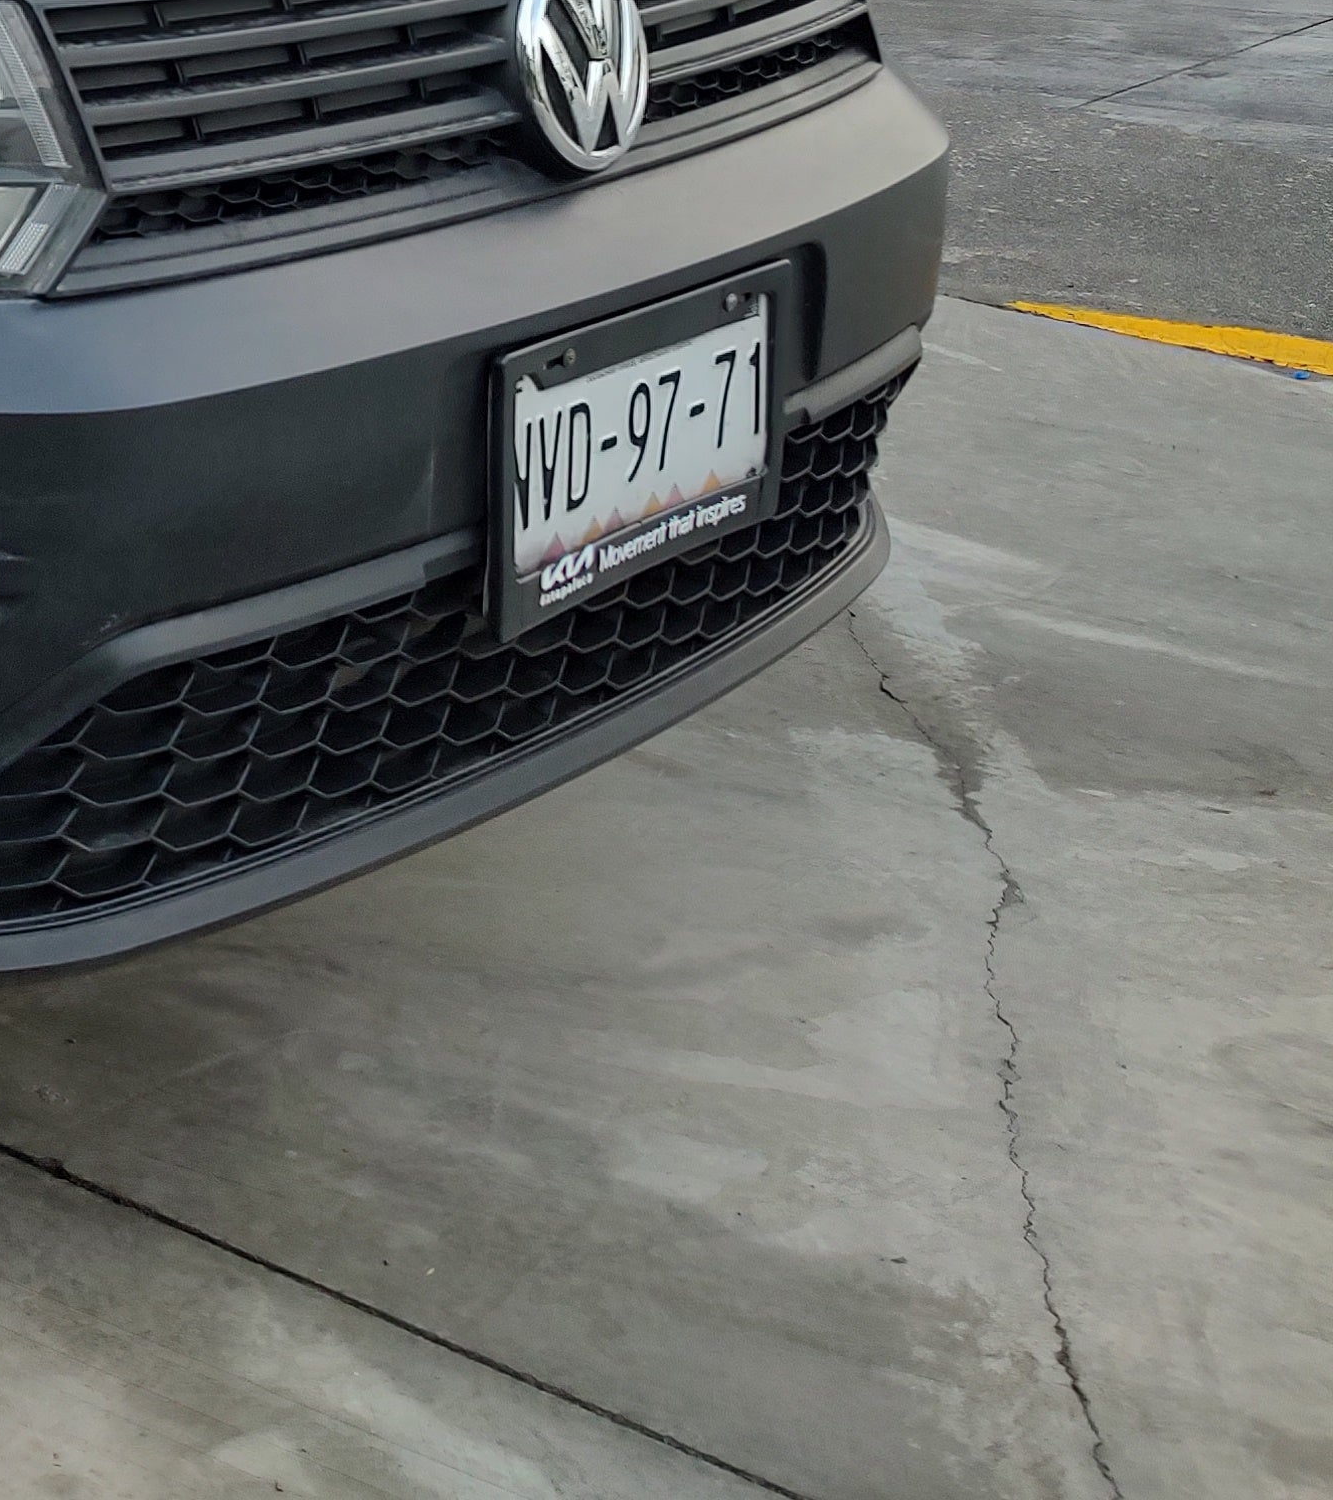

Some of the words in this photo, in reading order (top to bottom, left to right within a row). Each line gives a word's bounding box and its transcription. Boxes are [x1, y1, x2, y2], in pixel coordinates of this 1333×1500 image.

[599, 521, 668, 573] Movement
[668, 512, 696, 540] that
[696, 494, 748, 528] inspires
